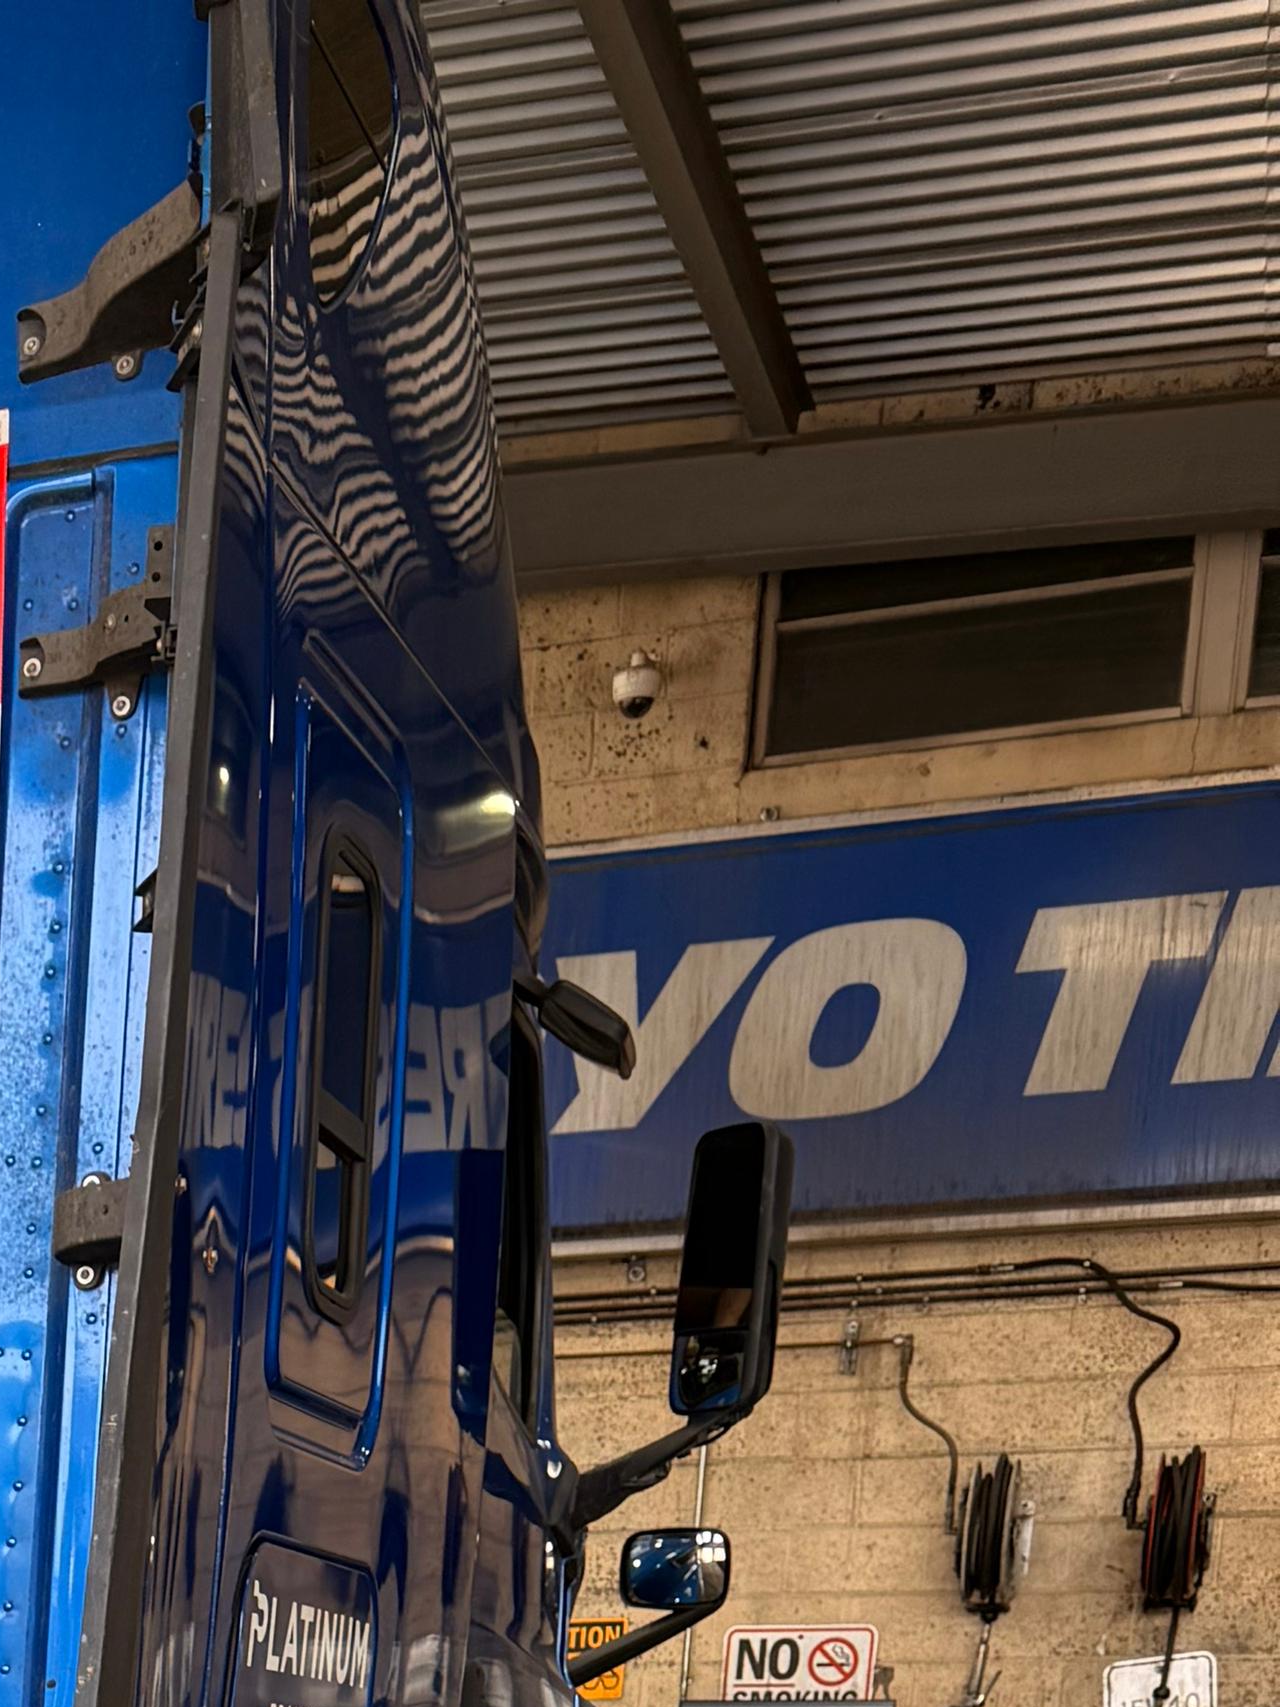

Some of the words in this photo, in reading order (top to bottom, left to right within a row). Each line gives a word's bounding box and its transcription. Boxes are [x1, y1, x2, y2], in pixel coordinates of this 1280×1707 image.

[1013, 885, 1280, 1098] TI
[246, 1579, 371, 1689] PLATINUM
[735, 1638, 800, 1681] NO
